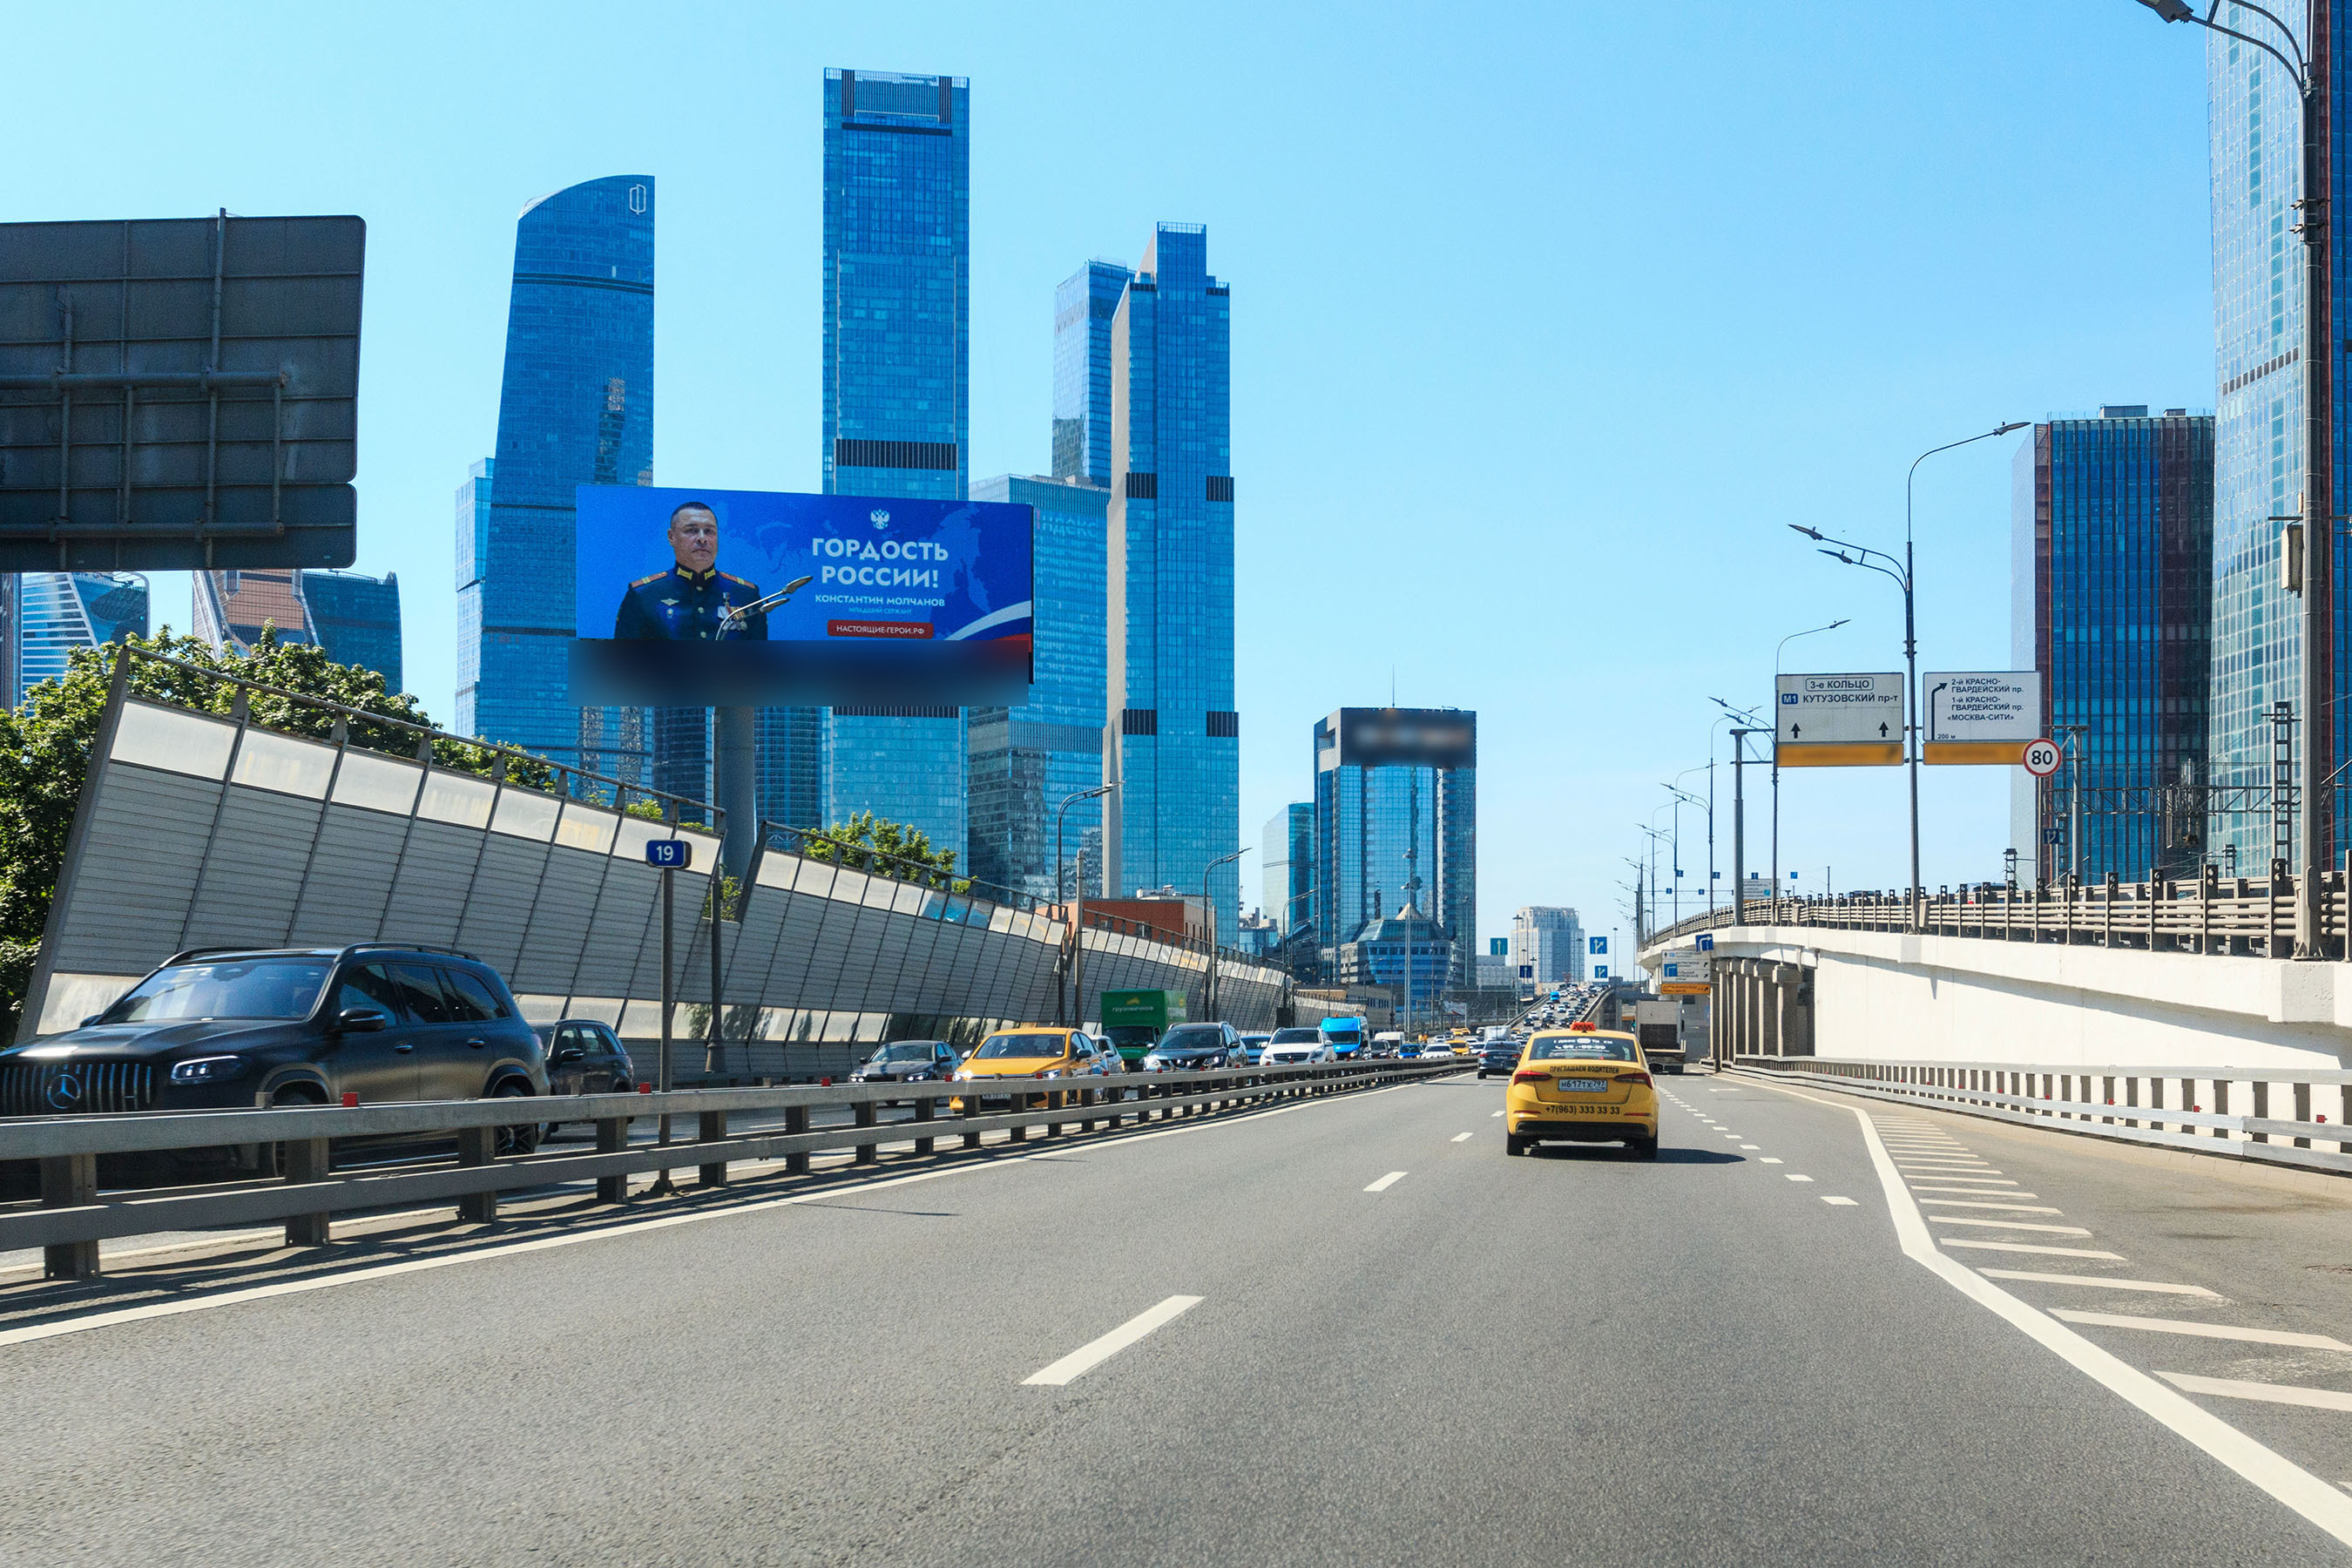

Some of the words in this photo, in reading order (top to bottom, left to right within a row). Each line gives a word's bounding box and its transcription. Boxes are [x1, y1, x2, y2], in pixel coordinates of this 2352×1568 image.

[812, 537, 949, 561] ГОРДОСТЬ
[821, 565, 938, 588] РОССИИ!
[814, 594, 883, 605] КОНСТАНТИН
[887, 596, 945, 607] МОЛЧАНОВ
[836, 625, 925, 635] НАСТОЯЩИЕ-ГЕРОИ.РФ
[1810, 680, 1824, 689] 3-е
[1827, 679, 1869, 690] КОЛЬЦО
[1951, 685, 2010, 693] ГВАРДЕЙСКИЙ
[1784, 694, 1797, 703] М1
[1802, 693, 1875, 703] КУТУЗОВСКИЙ
[1877, 694, 1898, 704] пр-т
[2031, 750, 2053, 765] 80
[656, 845, 674, 862] 19
[1587, 1065, 1619, 1074] ВОДИТЕЛЕЙ
[1545, 1105, 1578, 1115] +7(963)
[1578, 1105, 1595, 1114] 333
[1597, 1106, 1608, 1115] 33
[1609, 1106, 1620, 1115] 33
